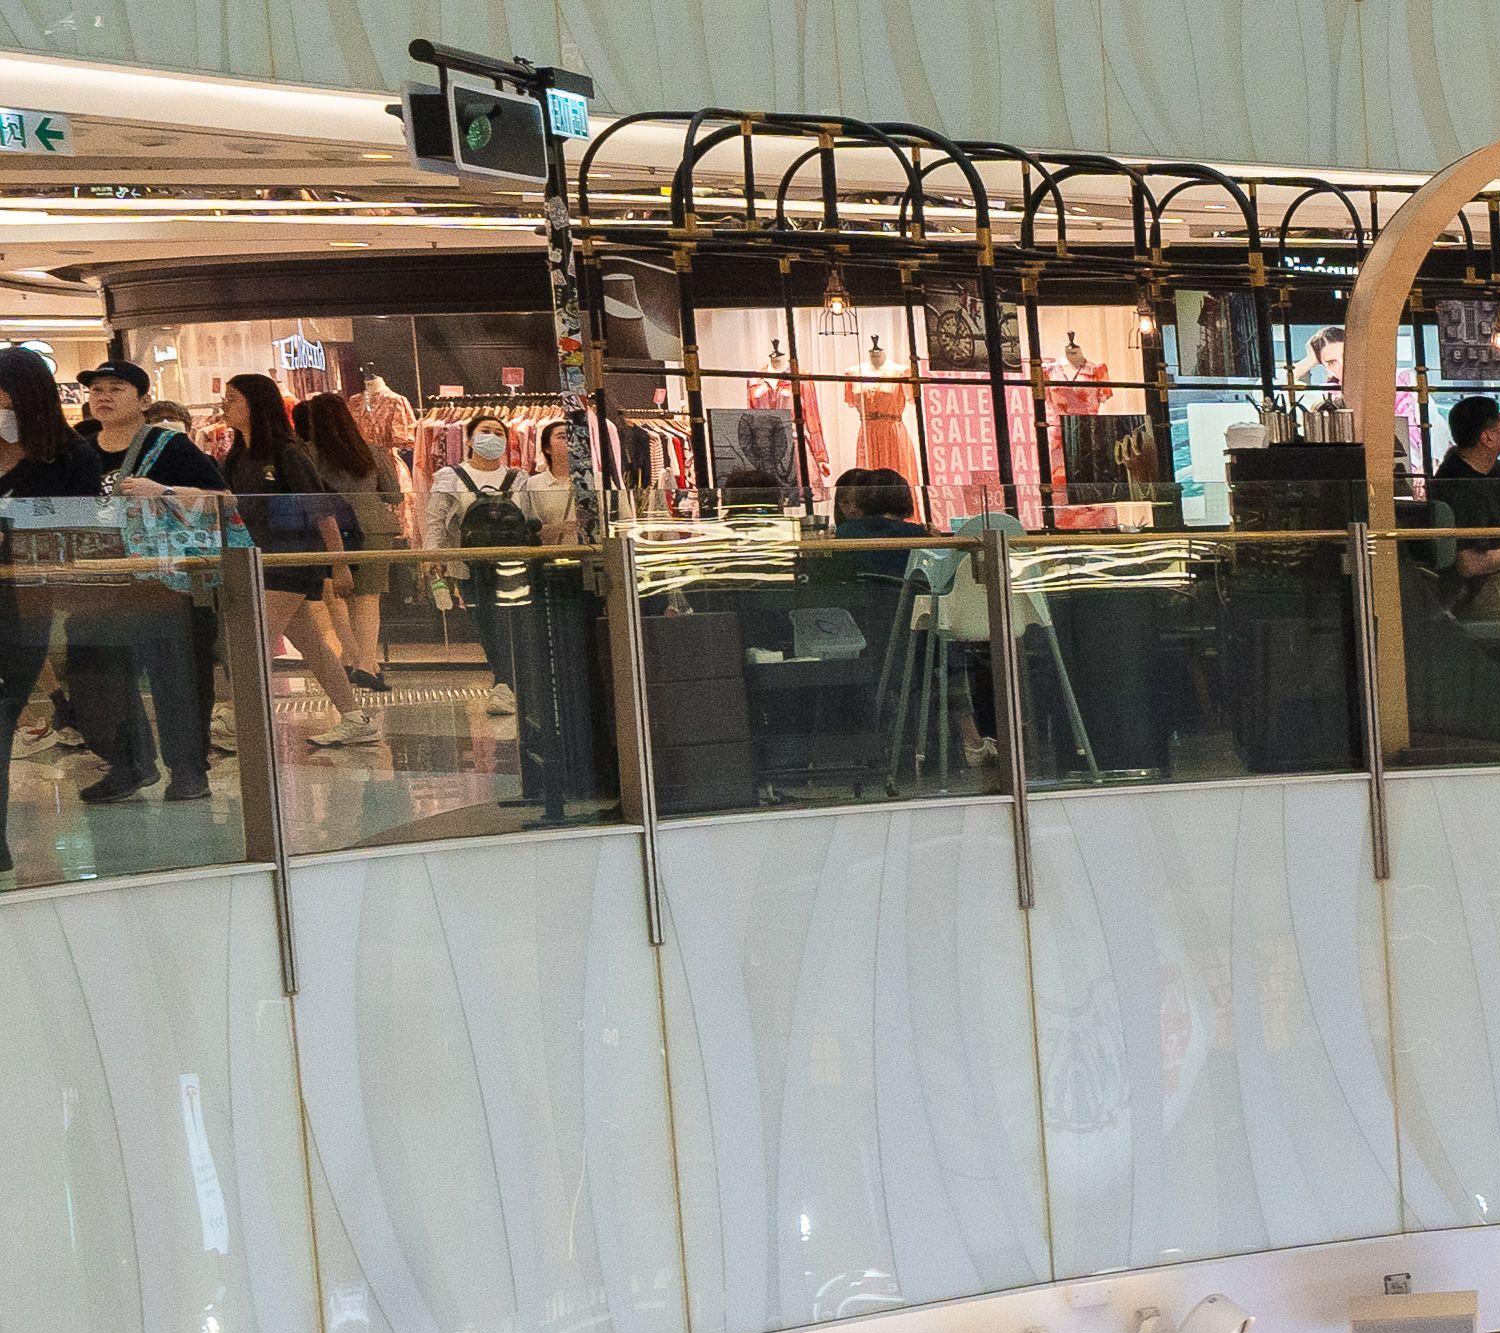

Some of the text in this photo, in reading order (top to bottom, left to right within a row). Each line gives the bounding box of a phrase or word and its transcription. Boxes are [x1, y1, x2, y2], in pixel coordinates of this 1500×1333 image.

[929, 389, 990, 416] SALE
[931, 417, 994, 445] SALE
[932, 446, 995, 472] SALE
